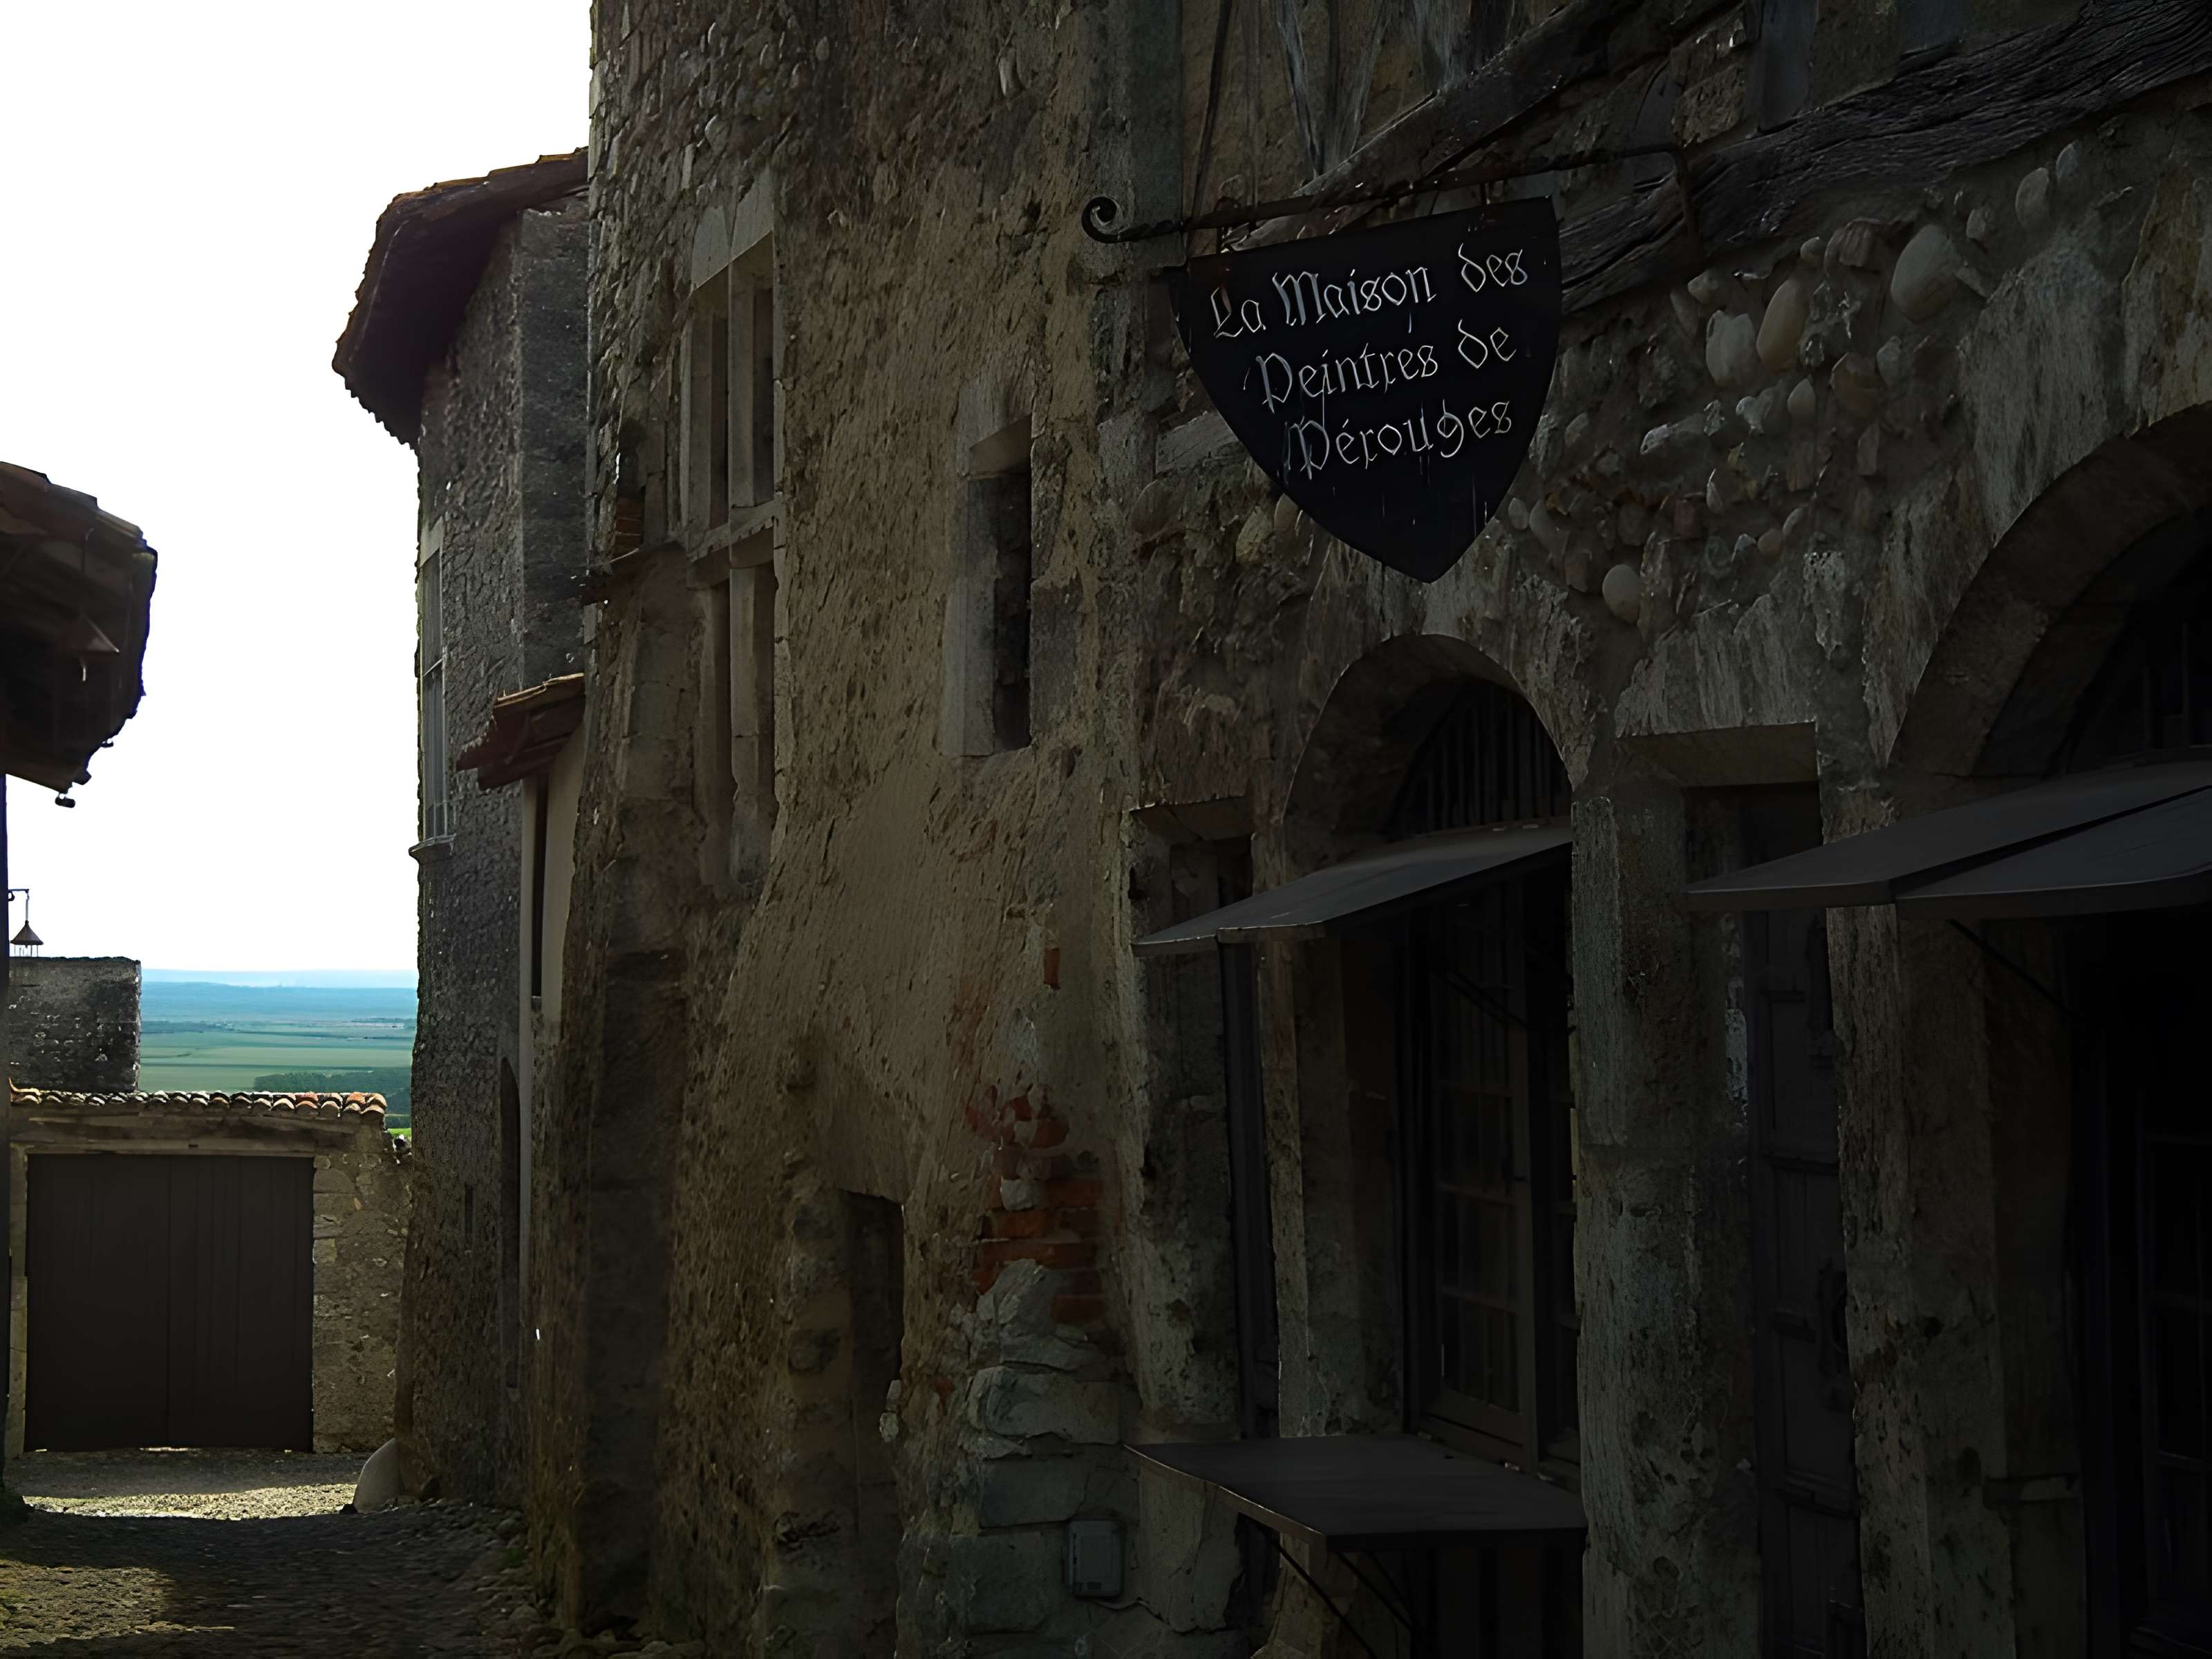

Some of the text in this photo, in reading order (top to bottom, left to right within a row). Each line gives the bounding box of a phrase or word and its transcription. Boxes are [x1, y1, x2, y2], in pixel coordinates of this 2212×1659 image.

[1210, 243, 1528, 338] La Maison des
[1255, 319, 1517, 414] Peintres de
[1287, 398, 1512, 480] Pérouges
